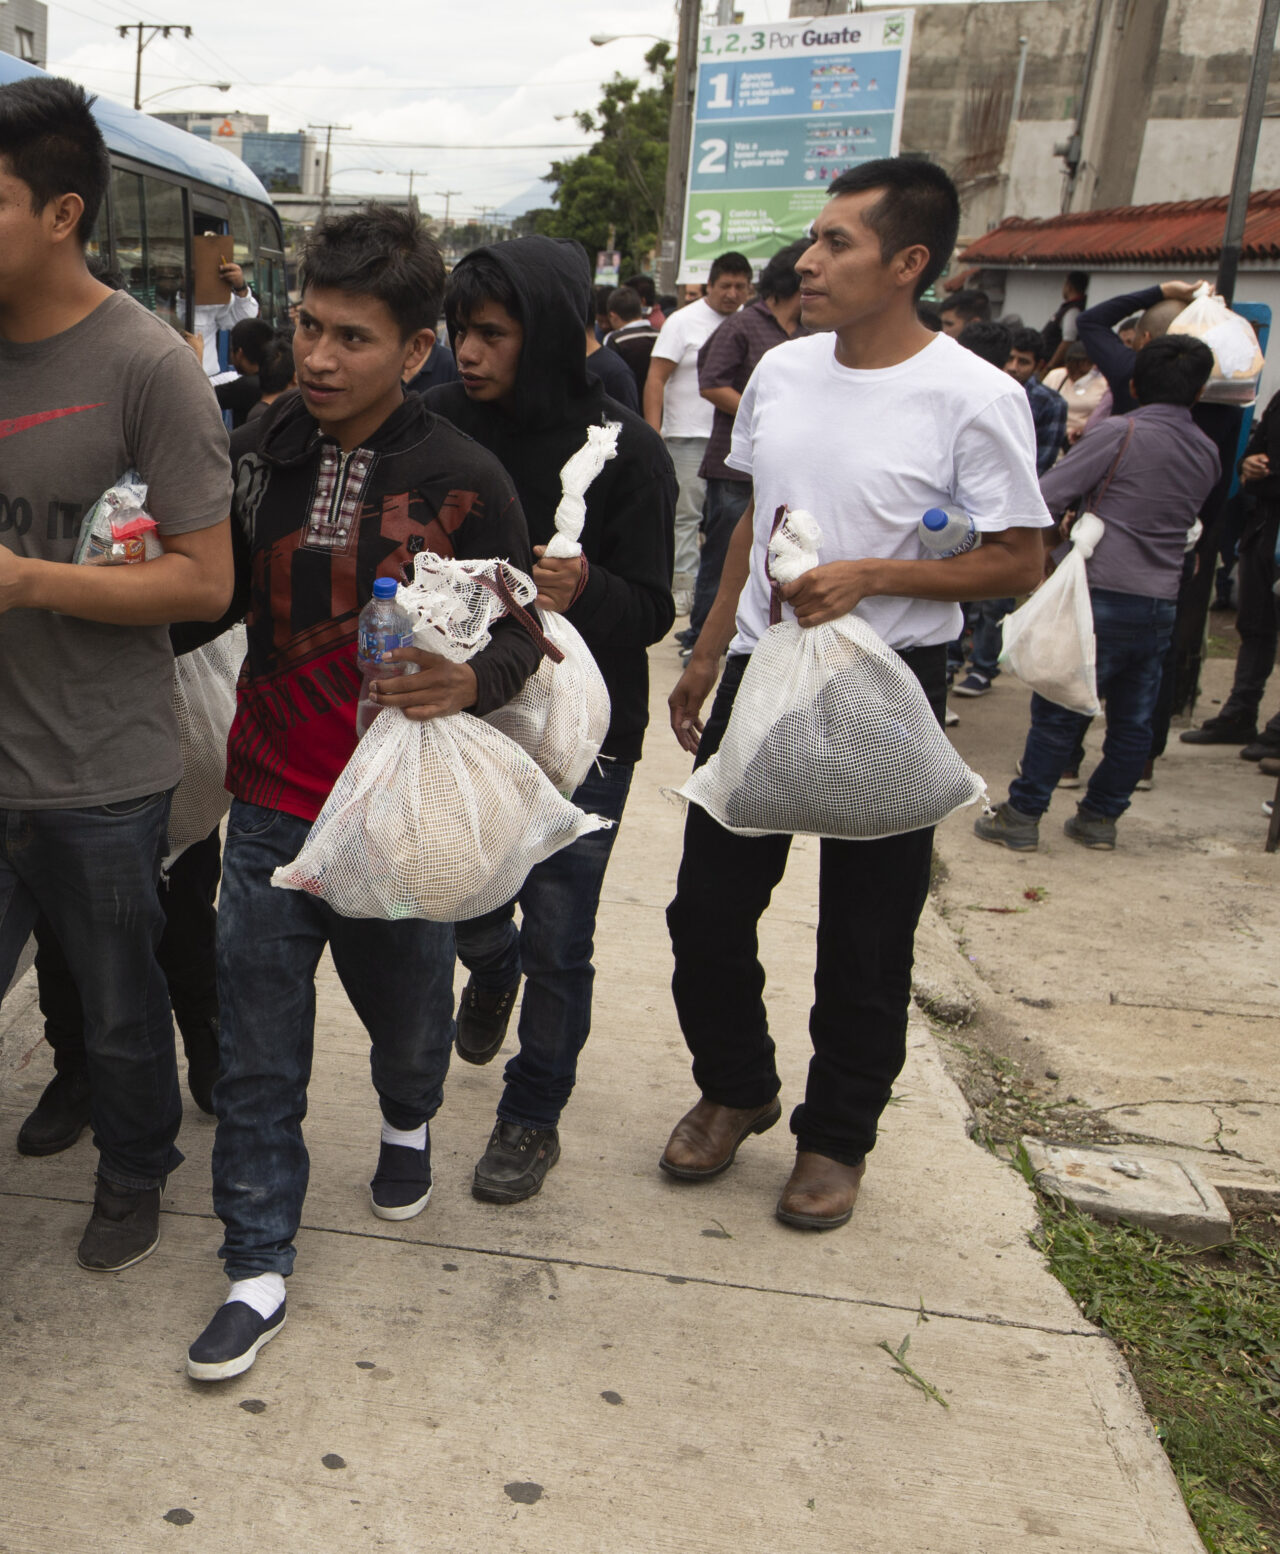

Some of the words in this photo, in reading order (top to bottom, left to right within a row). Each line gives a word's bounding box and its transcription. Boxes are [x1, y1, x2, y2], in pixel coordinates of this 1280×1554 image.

[700, 31, 765, 55] 1,2,3
[769, 31, 799, 50] Por
[802, 26, 862, 47] Guate
[706, 72, 732, 109] 1
[696, 138, 727, 174] 2
[734, 142, 750, 151] Vas
[691, 209, 722, 243] 3
